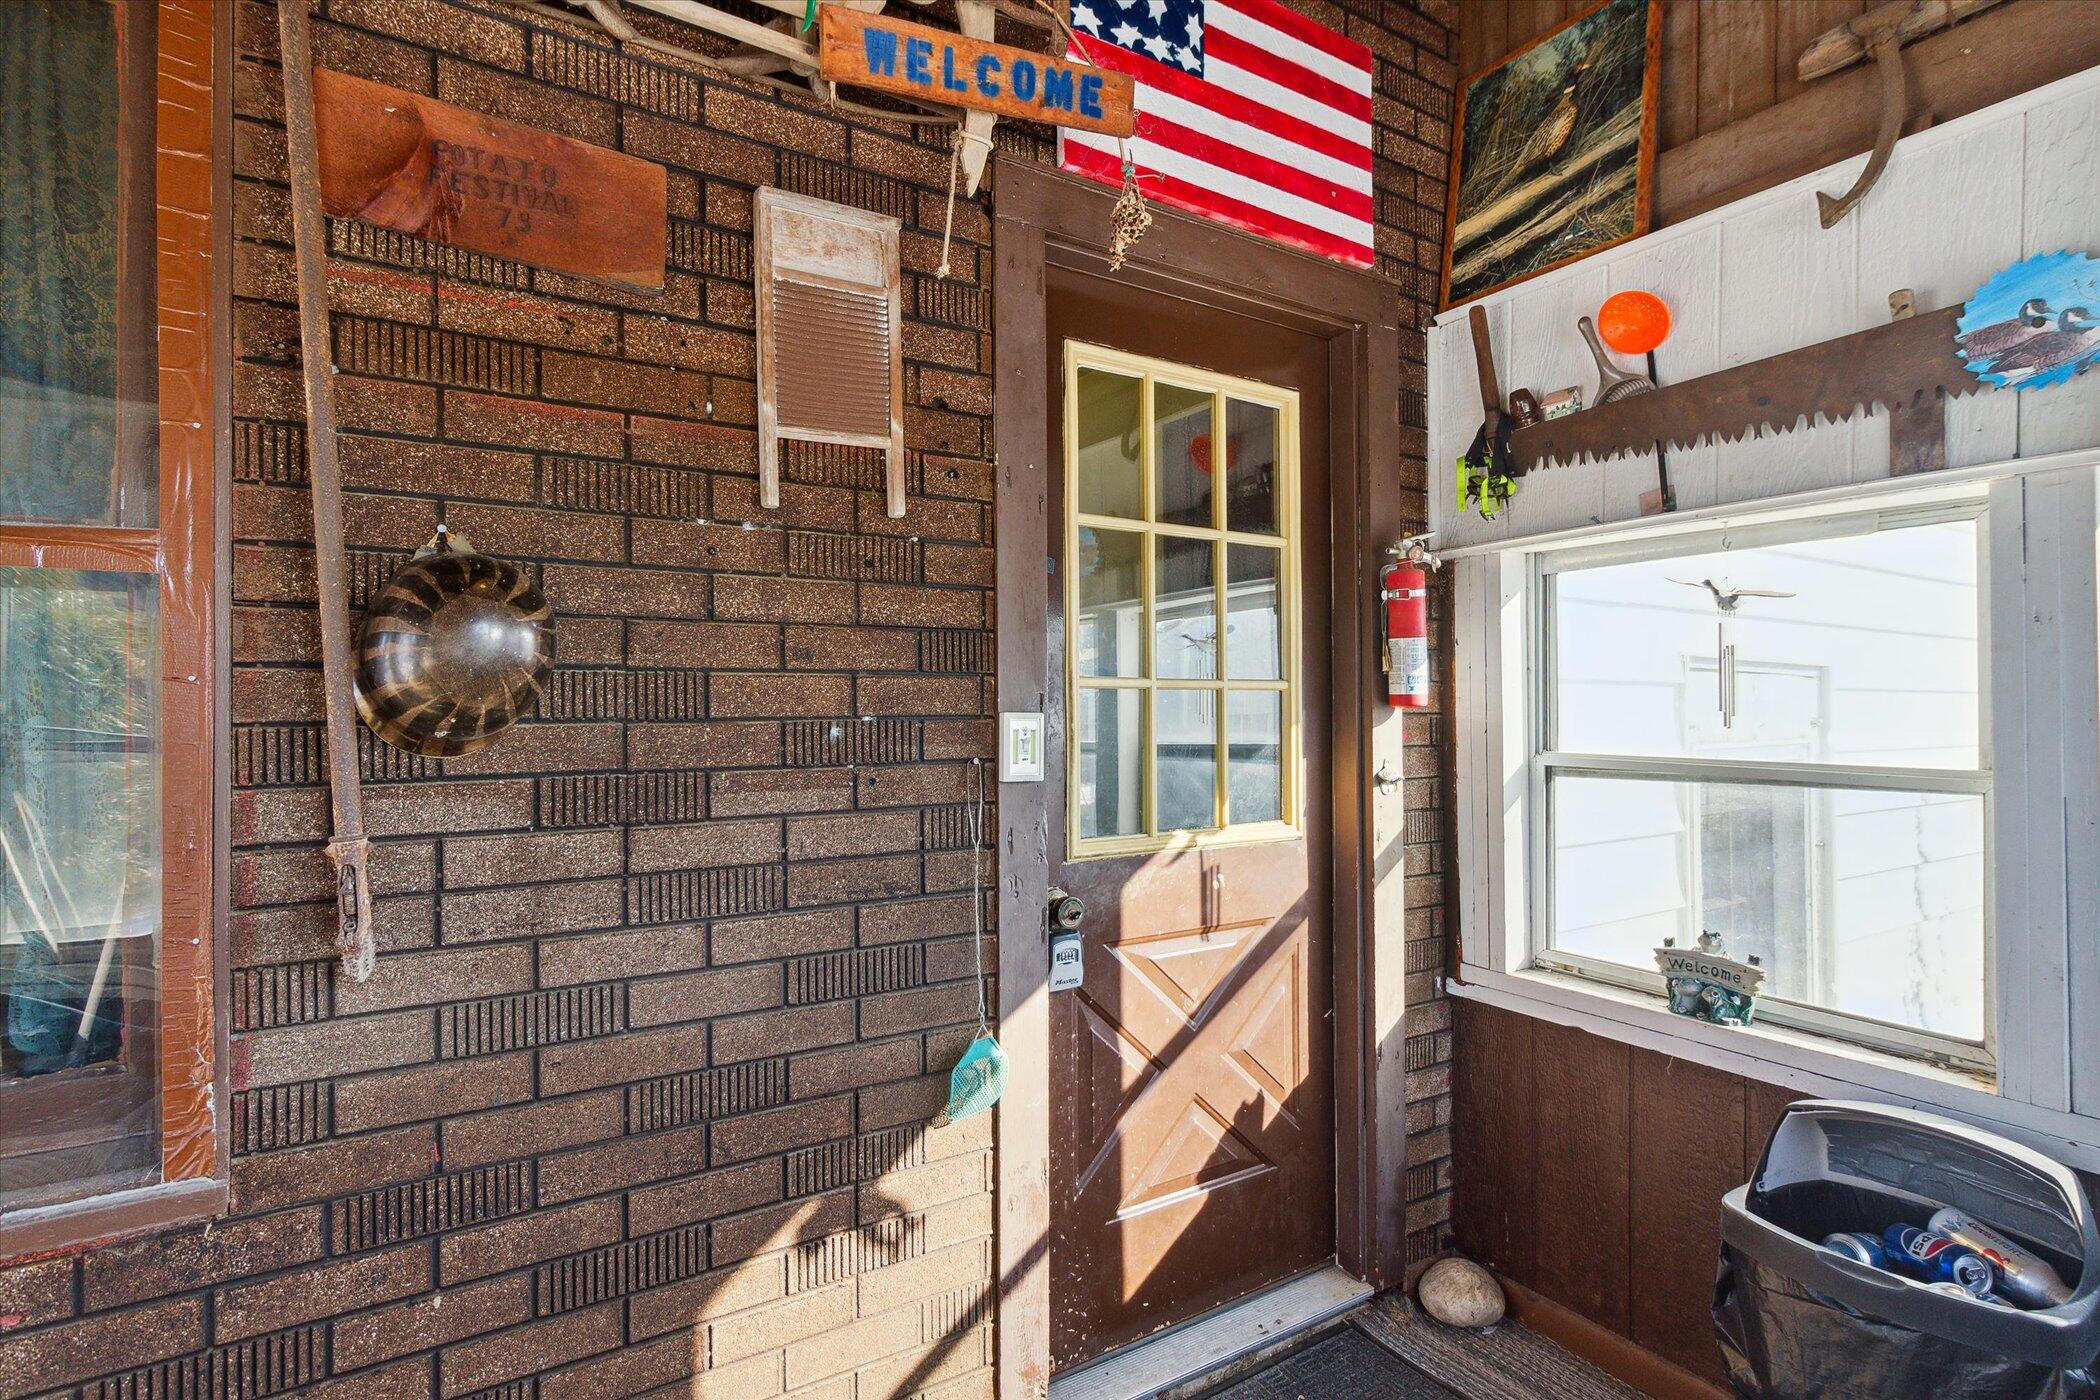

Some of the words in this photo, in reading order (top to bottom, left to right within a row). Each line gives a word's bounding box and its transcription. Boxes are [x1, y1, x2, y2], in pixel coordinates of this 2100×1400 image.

[863, 26, 1104, 120] WELCOME
[426, 162, 577, 219] FESTIVAL
[430, 138, 558, 189] POTATO
[1667, 957, 1741, 983] Welcome
